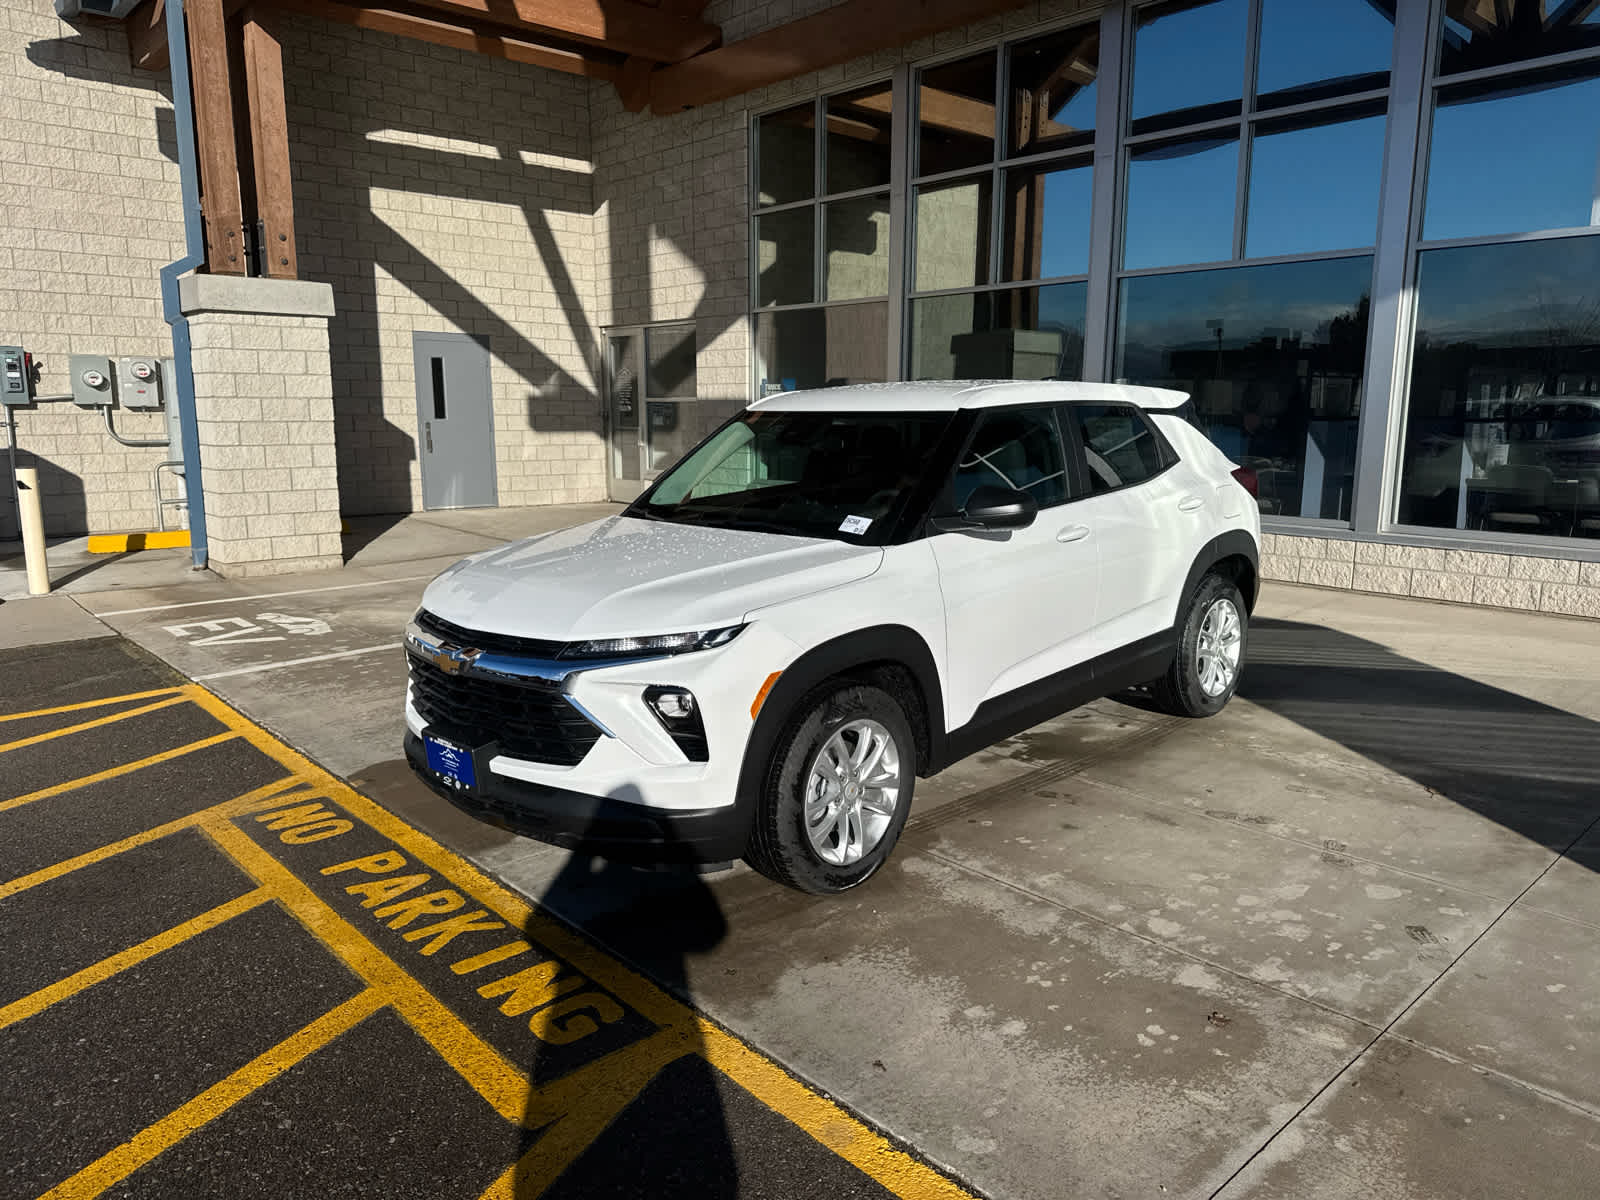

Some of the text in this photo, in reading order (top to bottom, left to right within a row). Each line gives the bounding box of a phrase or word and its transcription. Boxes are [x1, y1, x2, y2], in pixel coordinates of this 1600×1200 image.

[162, 616, 287, 647] EV
[254, 802, 625, 1046] NO PARKING
